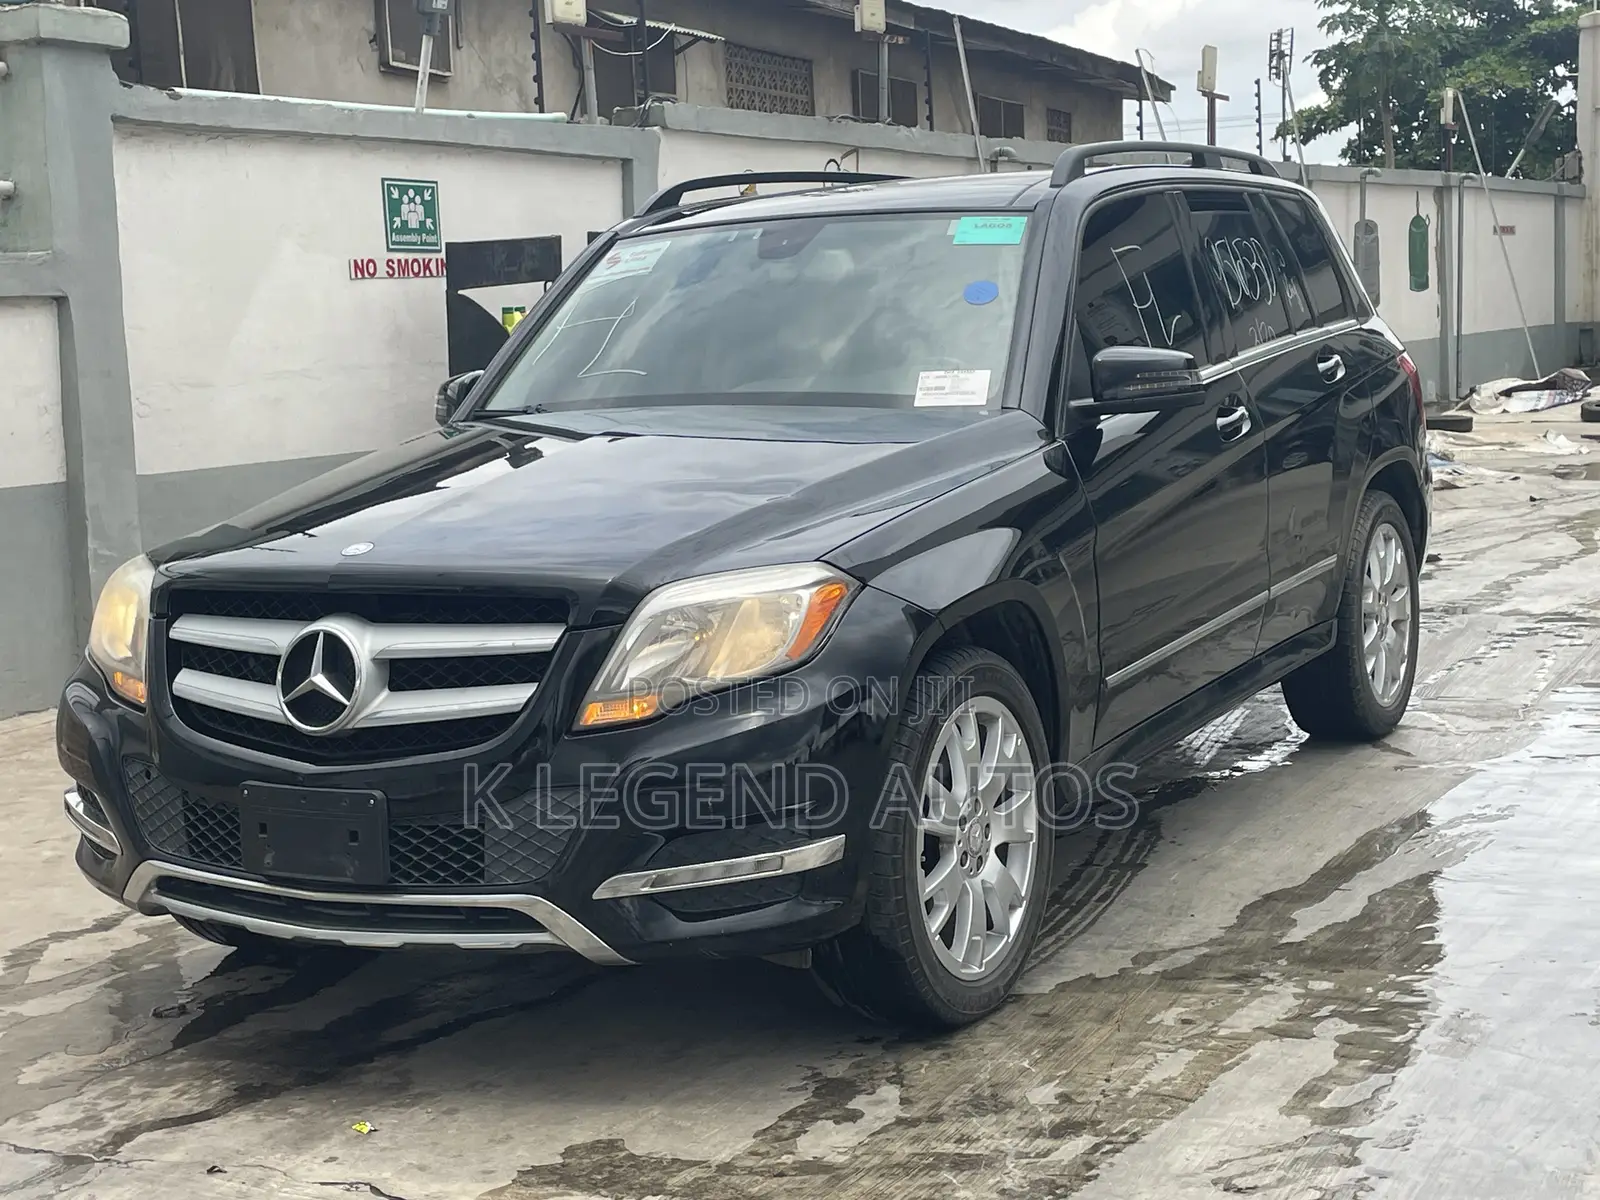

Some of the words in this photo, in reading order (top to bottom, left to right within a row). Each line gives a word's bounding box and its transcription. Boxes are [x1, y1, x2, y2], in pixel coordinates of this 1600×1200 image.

[391, 232, 421, 244] Assembly
[422, 233, 438, 243] Point
[353, 258, 377, 278] NO
[385, 257, 447, 278] SMOKIN
